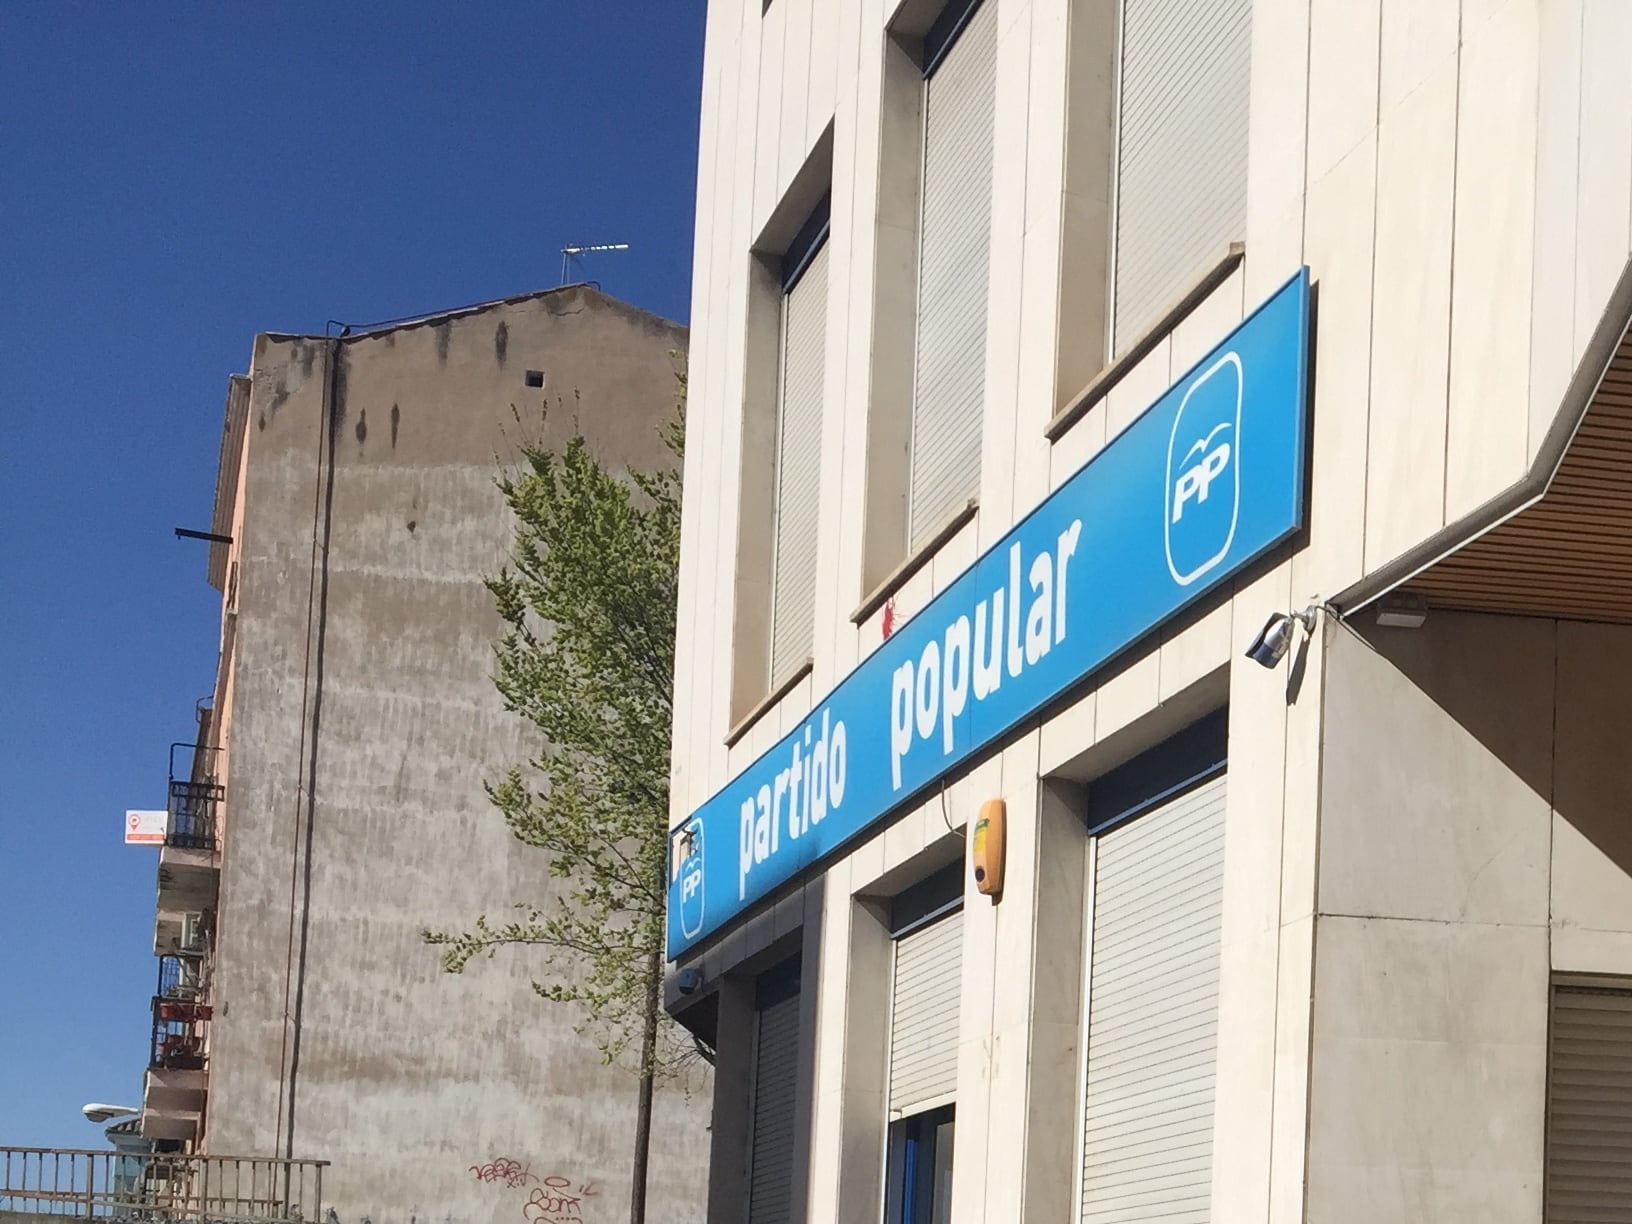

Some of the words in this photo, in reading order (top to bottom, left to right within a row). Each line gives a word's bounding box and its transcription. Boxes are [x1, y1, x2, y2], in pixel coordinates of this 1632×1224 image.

[1172, 441, 1231, 525] PP
[738, 709, 847, 902] partido
[890, 517, 1083, 791] popular
[681, 869, 702, 904] PP
